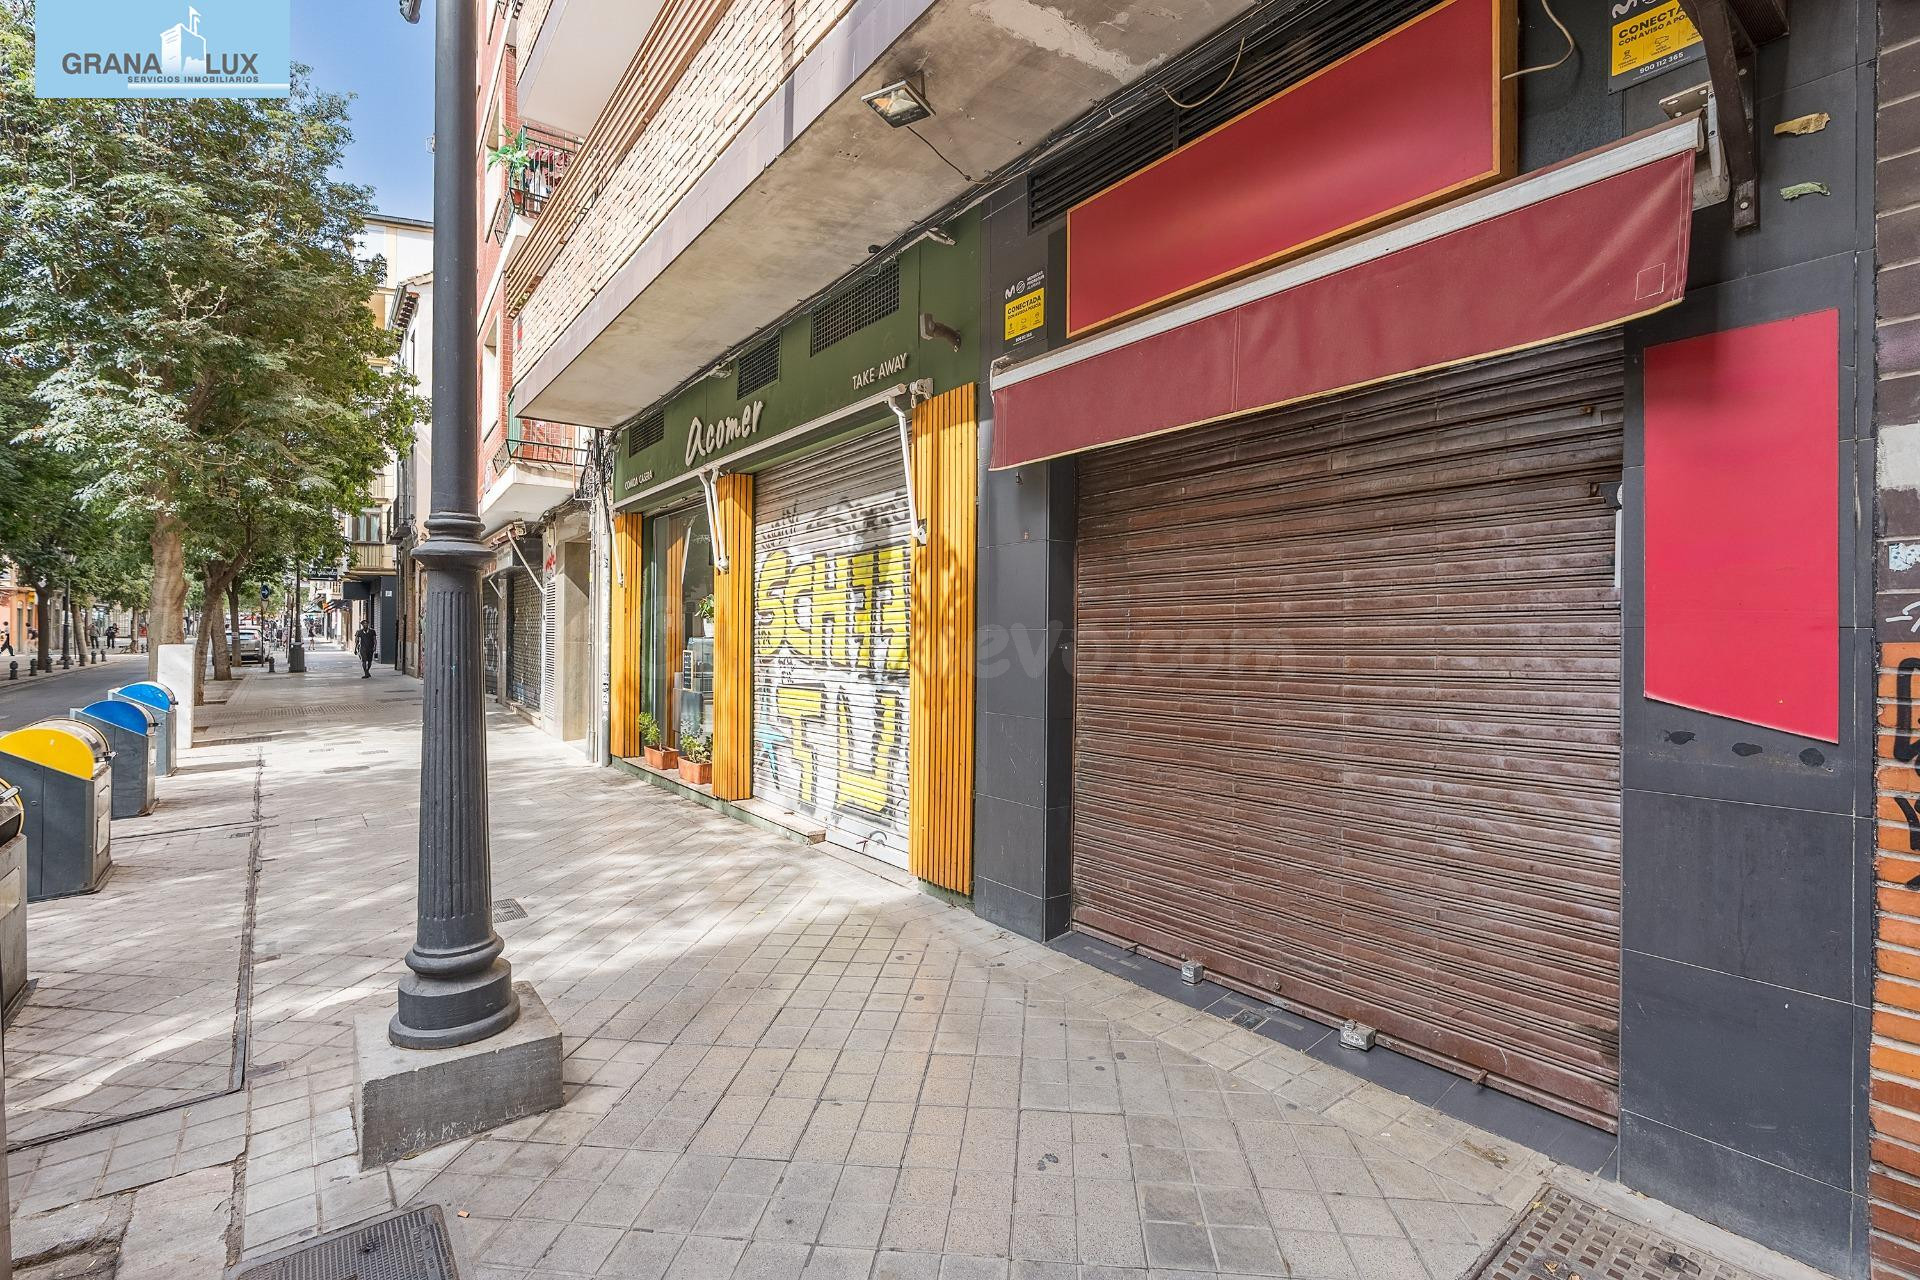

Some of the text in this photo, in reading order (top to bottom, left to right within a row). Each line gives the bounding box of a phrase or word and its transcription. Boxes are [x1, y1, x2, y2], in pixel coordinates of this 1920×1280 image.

[1618, 34, 1638, 46] CON
[1638, 23, 1664, 39] AVISO
[1639, 63, 1655, 74] 900
[1007, 295, 1042, 315] CONECTADA
[852, 352, 908, 390] TAKE AWAY
